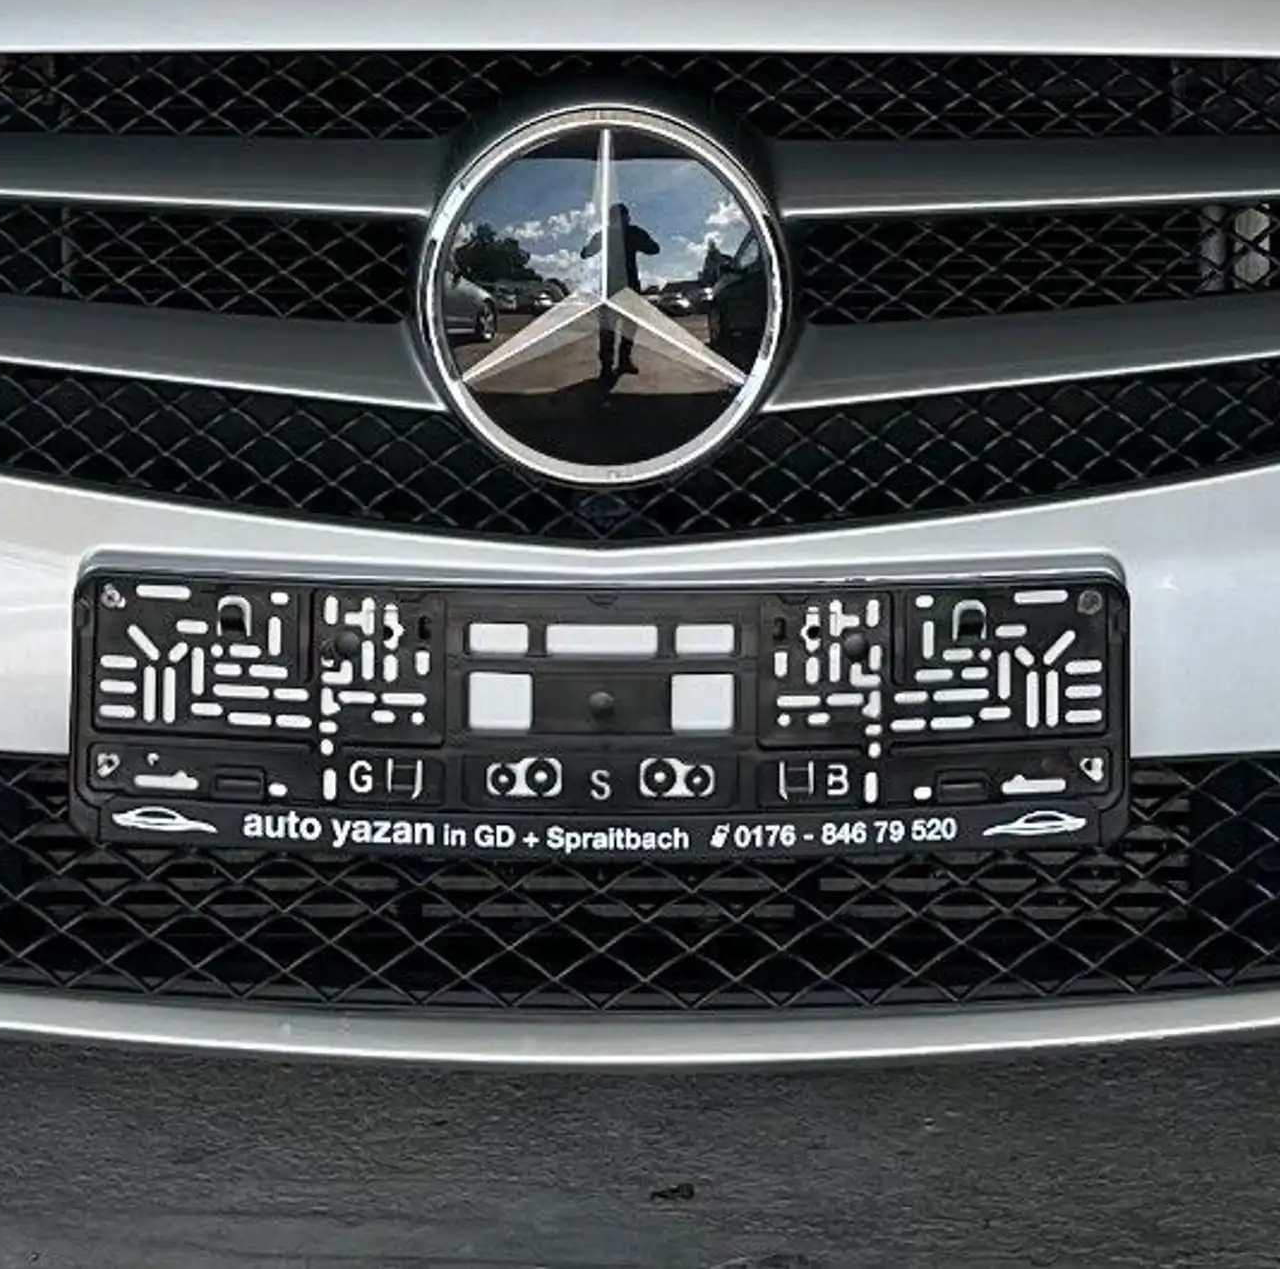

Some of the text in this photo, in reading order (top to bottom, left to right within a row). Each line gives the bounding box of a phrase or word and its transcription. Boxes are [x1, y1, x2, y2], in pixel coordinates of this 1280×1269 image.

[242, 810, 323, 841] auto
[330, 818, 435, 849] yazan
[442, 822, 467, 847] in
[473, 823, 516, 849] GD
[546, 825, 690, 854] Spraitbach
[733, 823, 797, 848] 0176
[820, 821, 868, 846] 846
[872, 819, 906, 844] 79
[910, 817, 959, 842] 520
